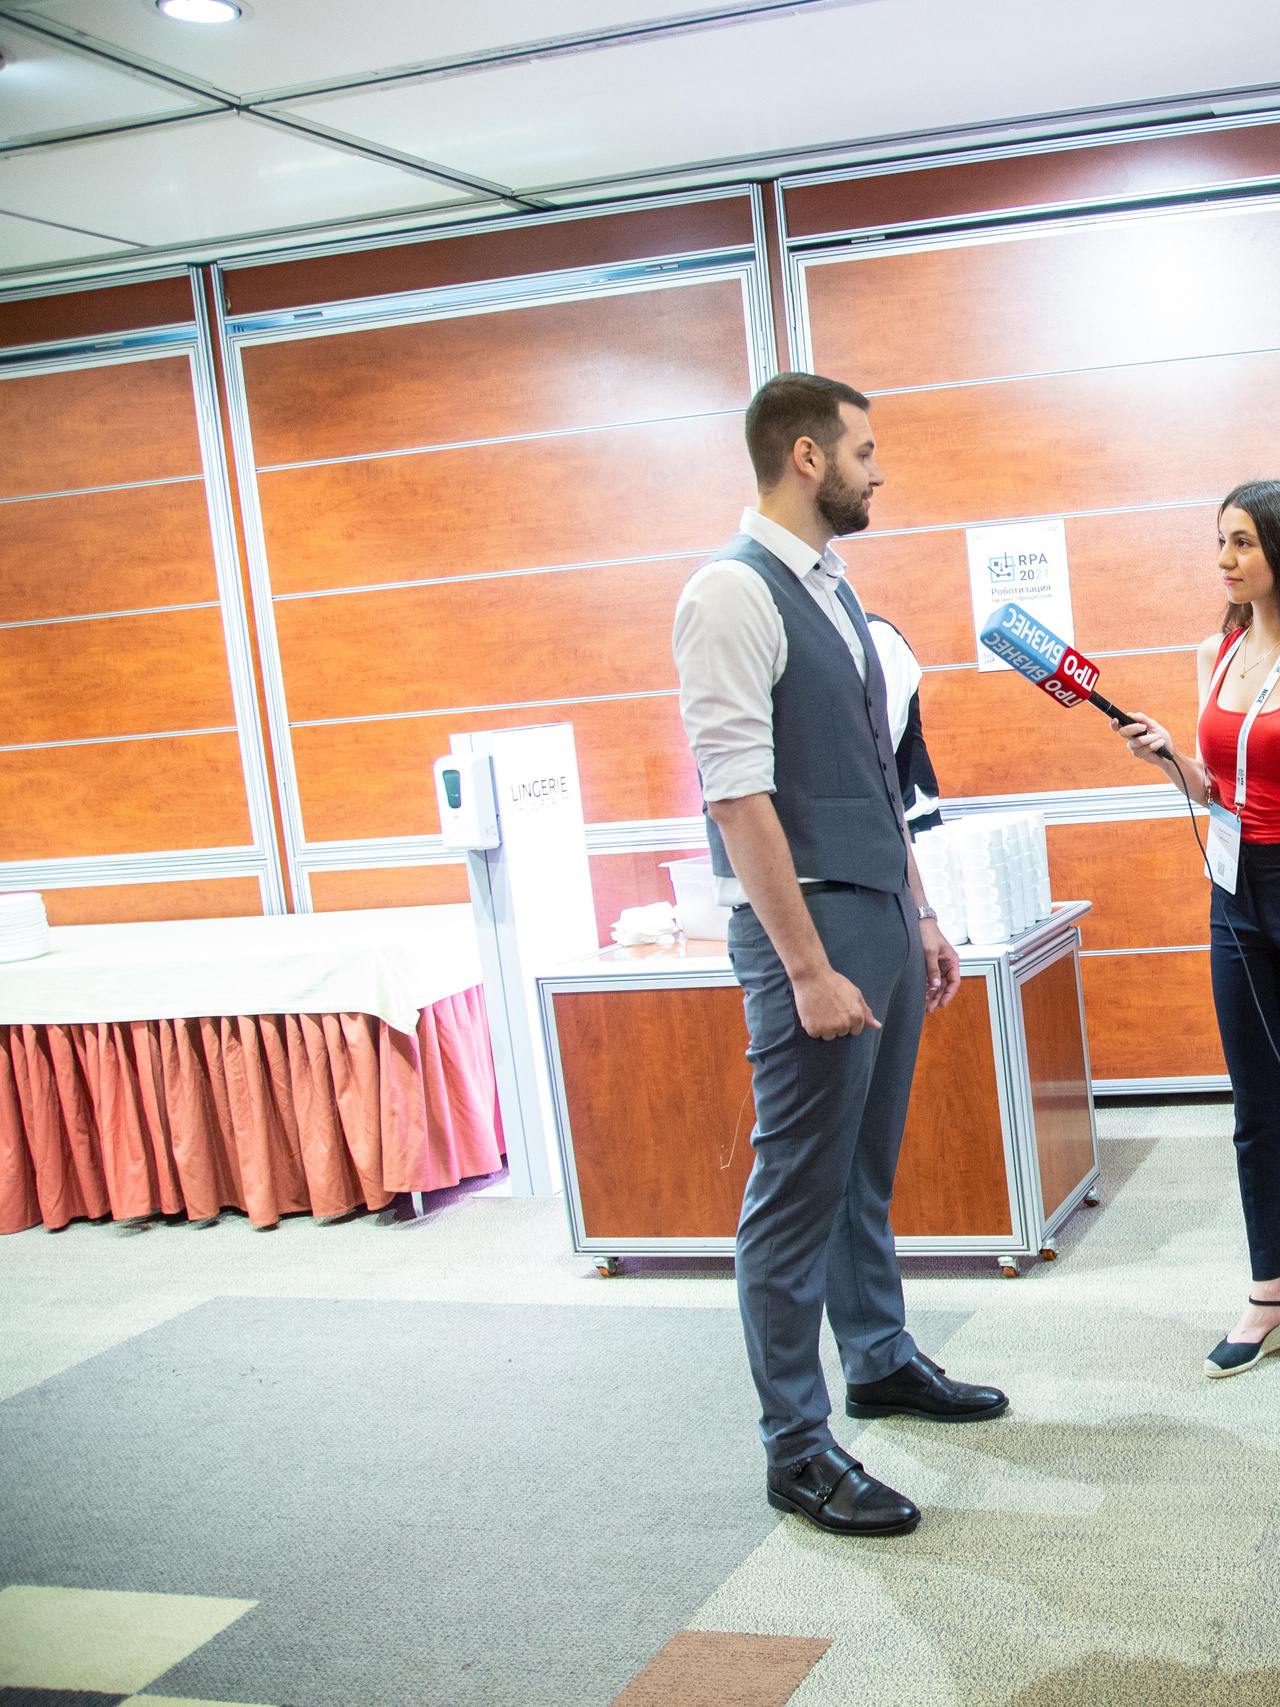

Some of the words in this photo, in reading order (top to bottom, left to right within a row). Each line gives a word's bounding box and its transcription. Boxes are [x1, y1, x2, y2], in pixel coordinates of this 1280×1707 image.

[1018, 552, 1048, 567] RPA
[1019, 568, 1049, 581] 2021
[991, 584, 1052, 596] Роботизация
[1002, 607, 1064, 667] БИЗНЕС
[984, 631, 1050, 682] БИЗНЕС
[1063, 655, 1099, 692] ПРО
[1044, 679, 1083, 708] ПРО
[1256, 688, 1269, 704] NICE
[510, 775, 568, 802] LINGERIE
